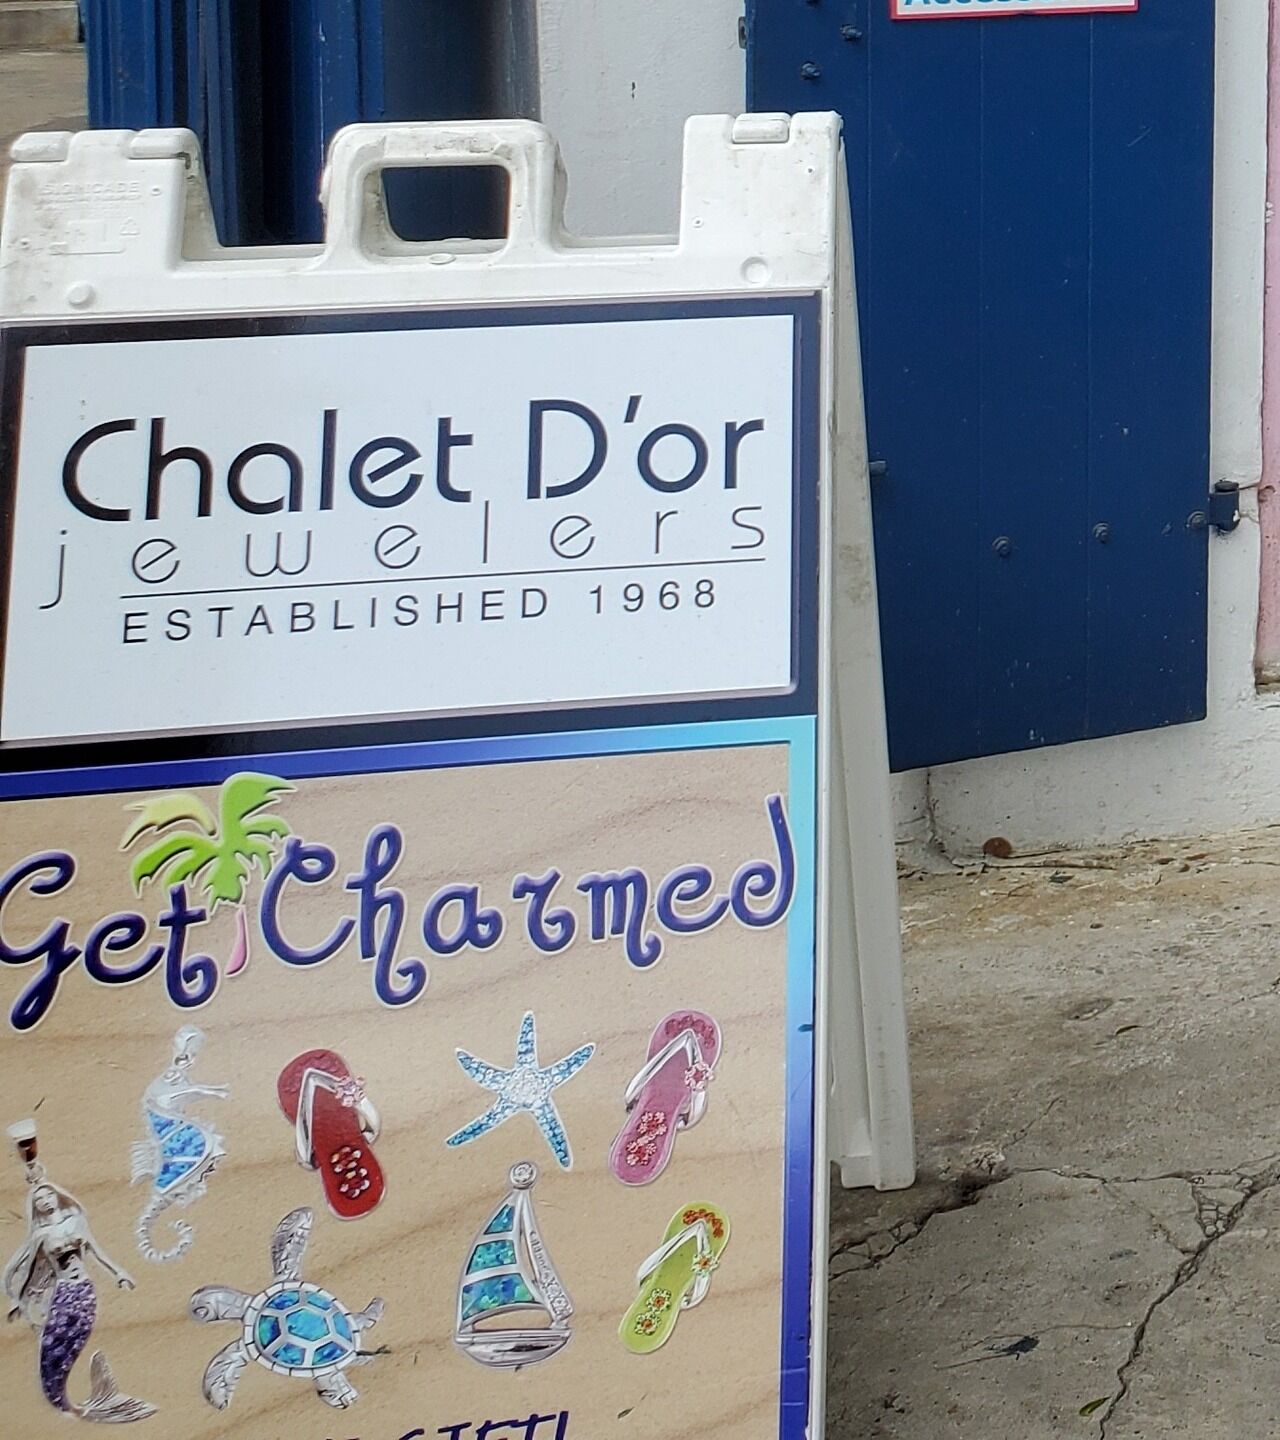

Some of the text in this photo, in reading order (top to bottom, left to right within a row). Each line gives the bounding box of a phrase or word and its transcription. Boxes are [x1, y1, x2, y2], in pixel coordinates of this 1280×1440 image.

[61, 395, 765, 522] Chalet D'or
[40, 501, 767, 610] jewelers
[121, 579, 717, 644] ESTABLISHED 1968
[0, 793, 796, 1031] Get Charmed
